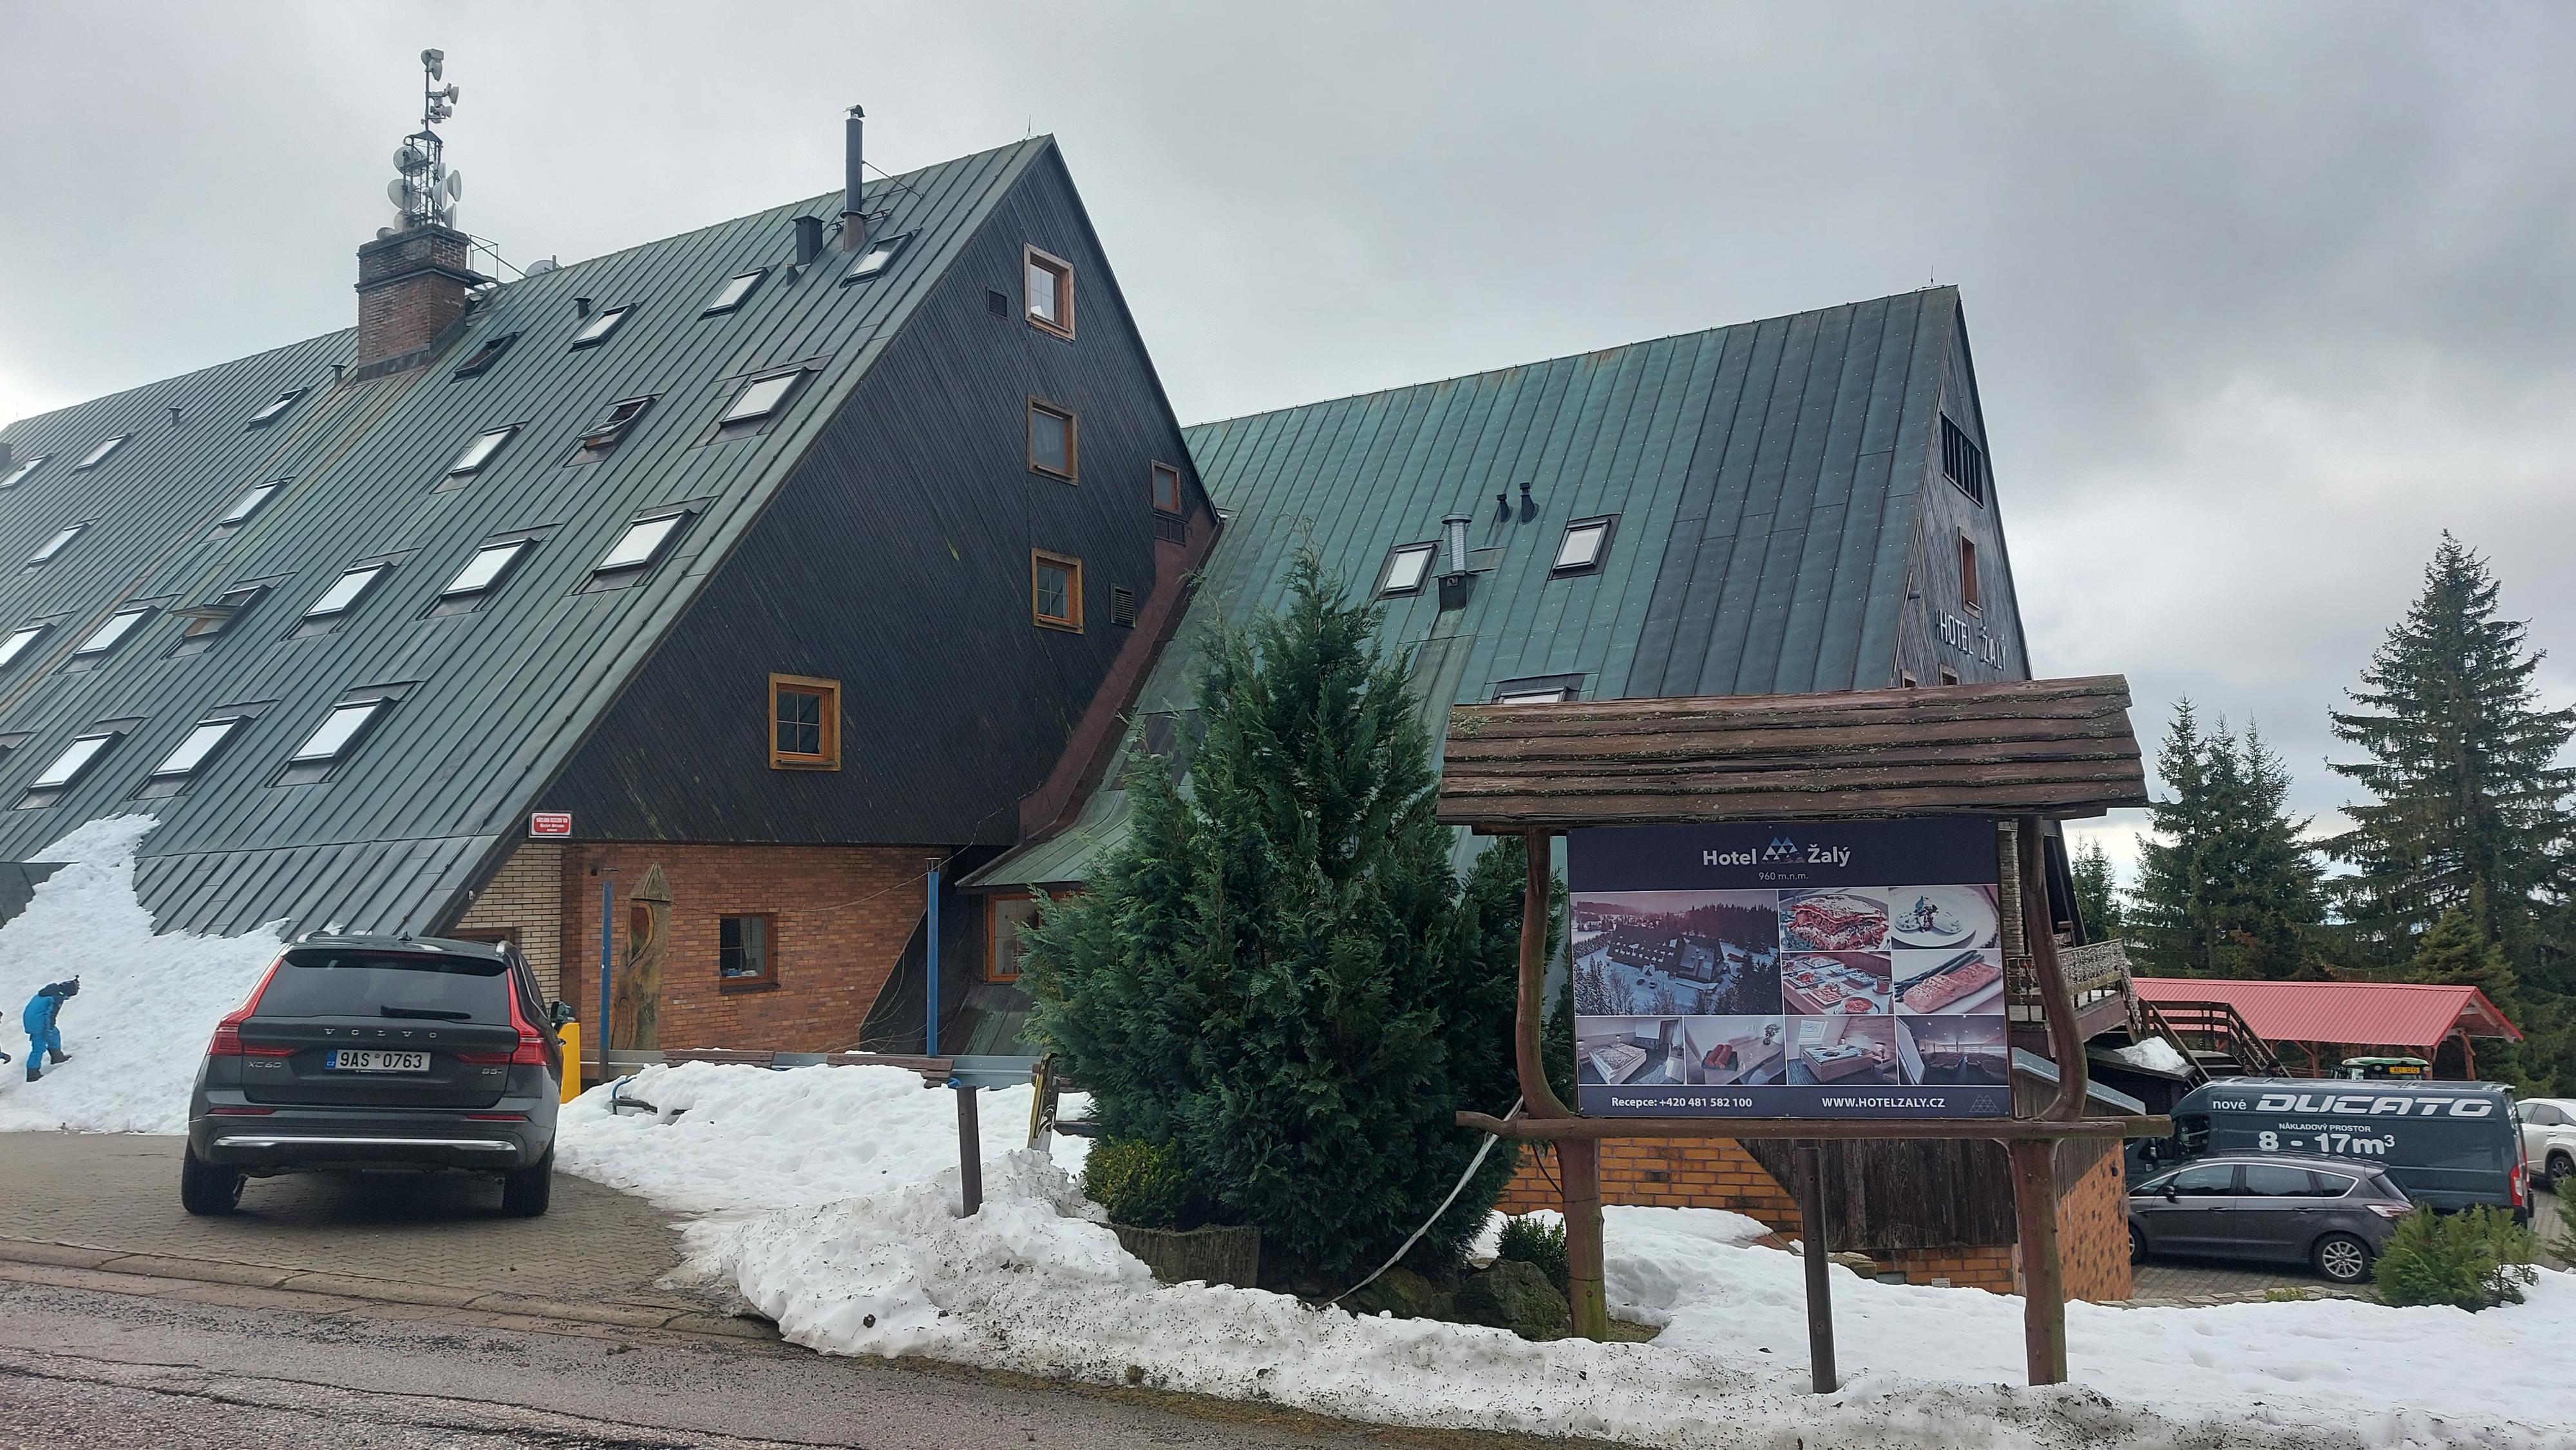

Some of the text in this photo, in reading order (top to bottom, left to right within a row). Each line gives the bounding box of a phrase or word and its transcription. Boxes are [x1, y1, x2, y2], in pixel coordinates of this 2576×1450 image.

[1937, 609, 2006, 671] HOTEL ŽALÝ
[1702, 843, 1851, 867] Hotel Žalý
[1758, 872, 1776, 881] 960
[339, 1052, 422, 1069] 9AS 0763
[1611, 1097, 1753, 1109] Recepce: +420 481 582 100
[1822, 1097, 1946, 1107] WWW.HOTELZALY.CZ
[2212, 1094, 2493, 1117] nové DUCATO
[2278, 1122, 2371, 1133] NÁKLADOVÝ PROSTOR
[2259, 1131, 2279, 1151] 8
